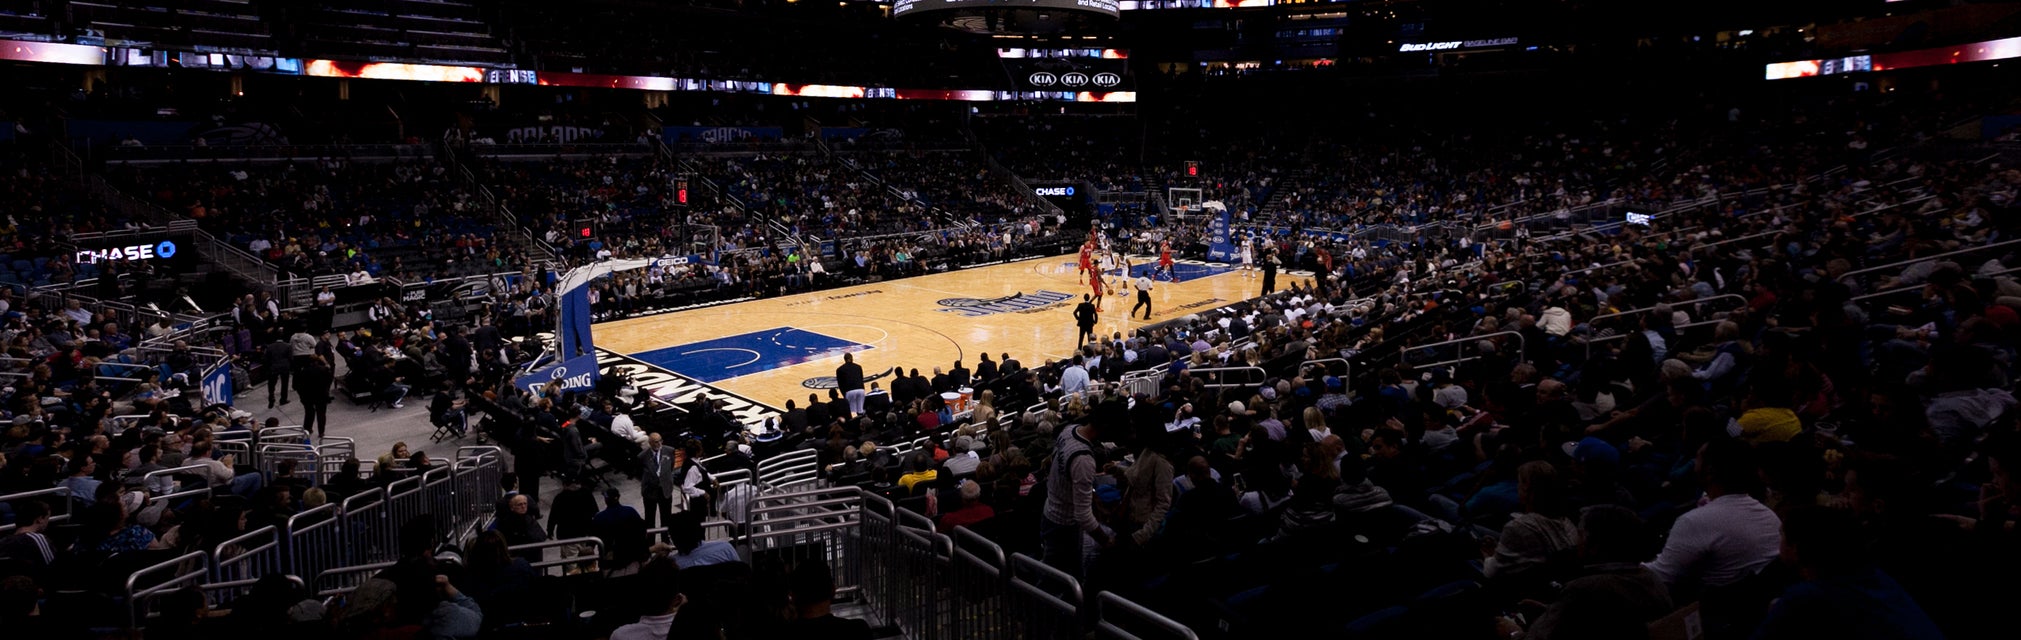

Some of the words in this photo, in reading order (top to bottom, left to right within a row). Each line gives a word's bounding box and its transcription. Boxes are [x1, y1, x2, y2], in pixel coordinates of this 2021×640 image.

[1034, 75, 1052, 84] KIA
[1065, 75, 1084, 84] KIA
[1097, 75, 1115, 84] KIA
[1036, 187, 1066, 195] CHASE
[76, 244, 154, 264] CHASE
[657, 257, 688, 267] GEICO
